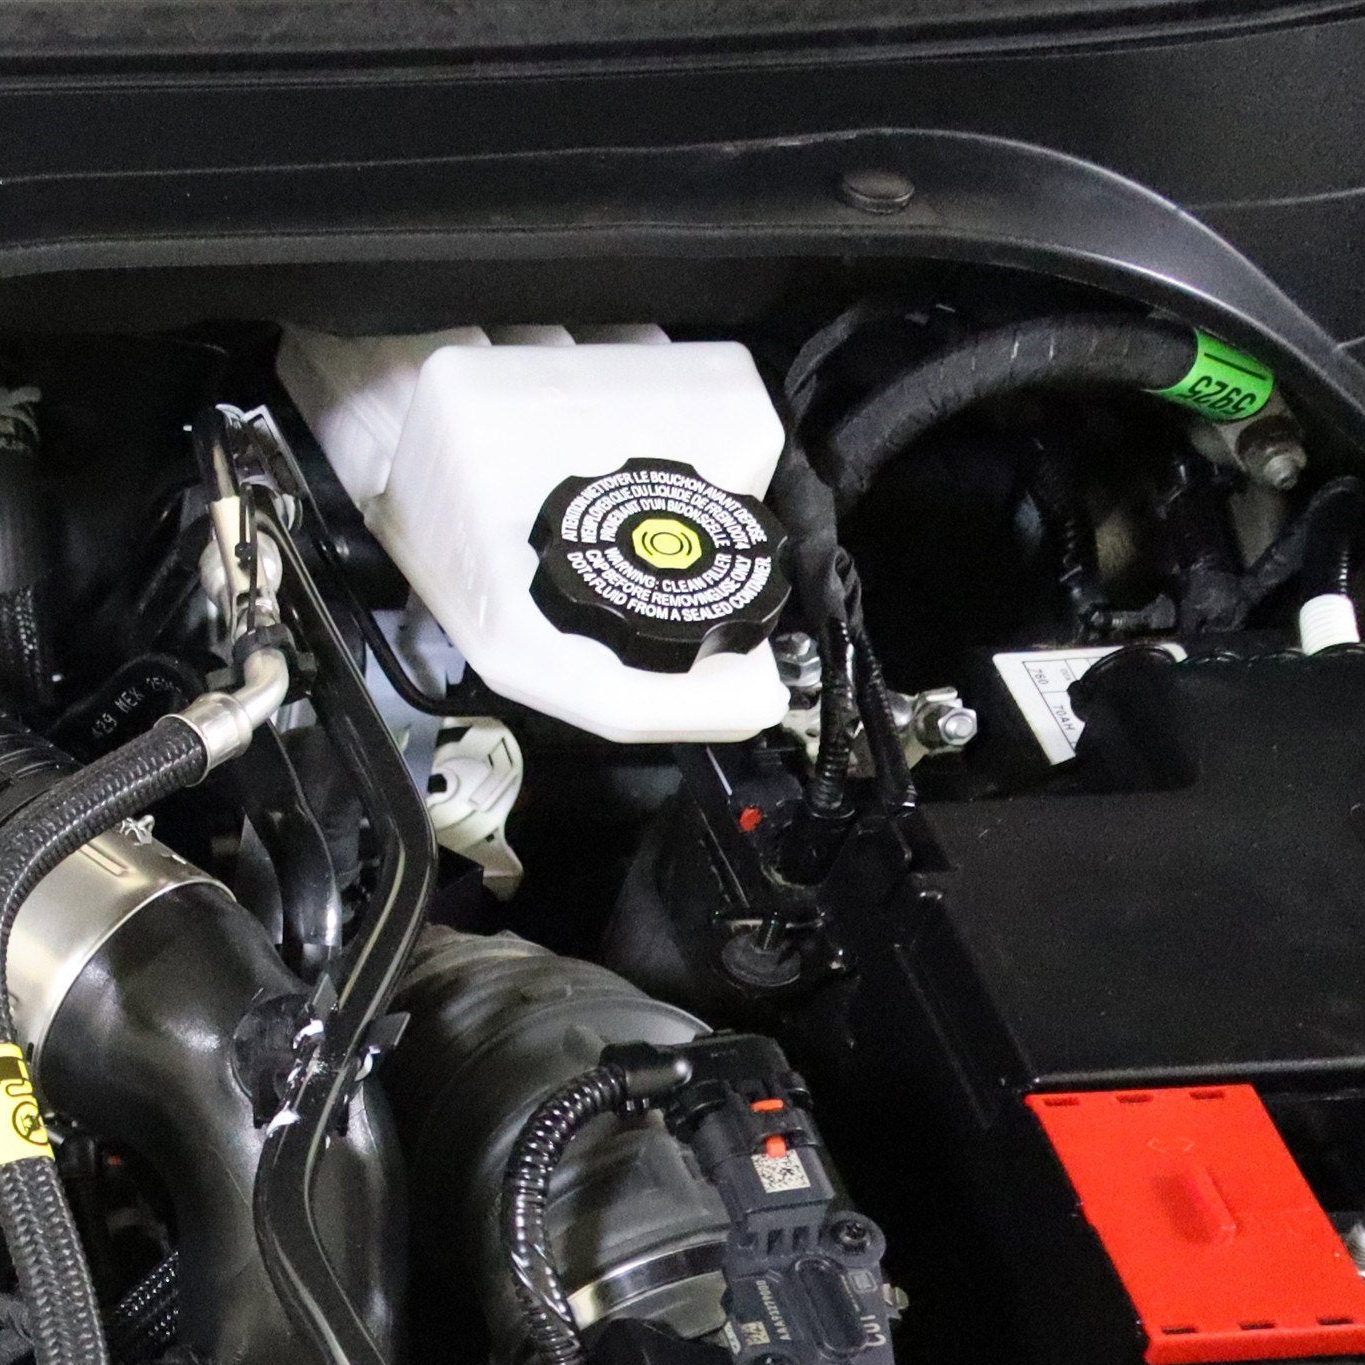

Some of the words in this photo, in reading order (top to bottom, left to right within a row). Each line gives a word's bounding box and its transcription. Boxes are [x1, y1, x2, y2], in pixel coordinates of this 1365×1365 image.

[1177, 375, 1257, 415] 5925
[606, 486, 634, 503] QUE
[646, 484, 693, 502] LIQUIDE
[702, 501, 737, 527] FREIN
[648, 470, 707, 493] BOUCHON
[701, 484, 742, 512] AVANT
[637, 497, 665, 510] D'UN
[667, 498, 703, 520] BIDON
[694, 512, 730, 548] SCELLE
[585, 549, 610, 571] CAP
[601, 568, 652, 602] BEFORE
[730, 554, 752, 582] ONLY
[604, 547, 659, 590] WARNING:
[662, 577, 708, 593] CLEAN
[702, 553, 732, 585] FILLER
[588, 577, 628, 605] FLUID
[626, 598, 669, 620] FROM
[681, 600, 734, 622] SEALED
